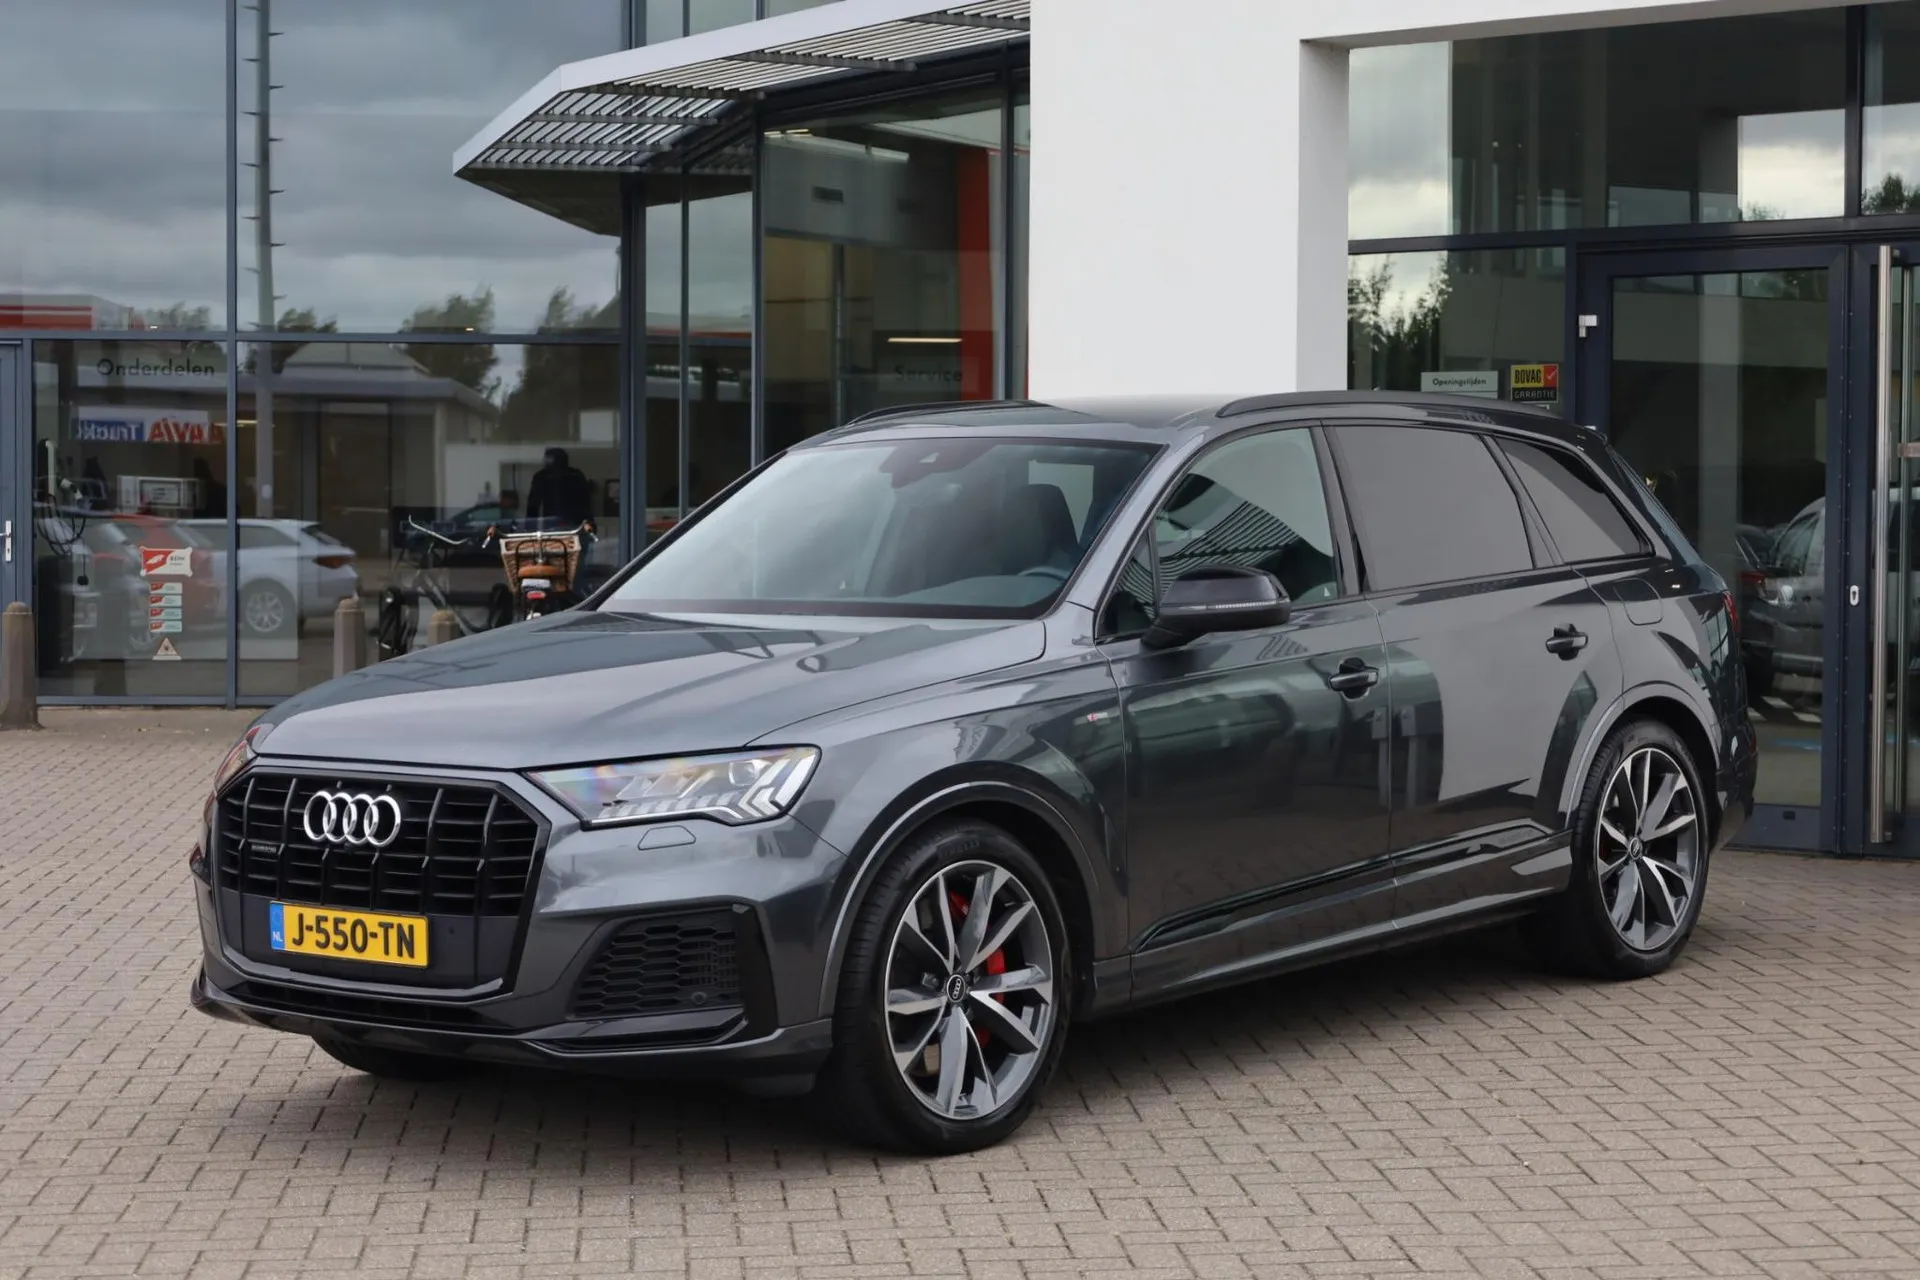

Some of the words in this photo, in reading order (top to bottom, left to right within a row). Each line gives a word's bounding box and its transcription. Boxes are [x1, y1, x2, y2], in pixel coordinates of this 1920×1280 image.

[97, 358, 215, 376] Onderdelen
[894, 364, 963, 382] Service
[1432, 377, 1487, 386] Openingstijden
[1515, 369, 1542, 384] BOVAG
[272, 932, 283, 942] NL
[292, 912, 415, 959] J-550-TN
